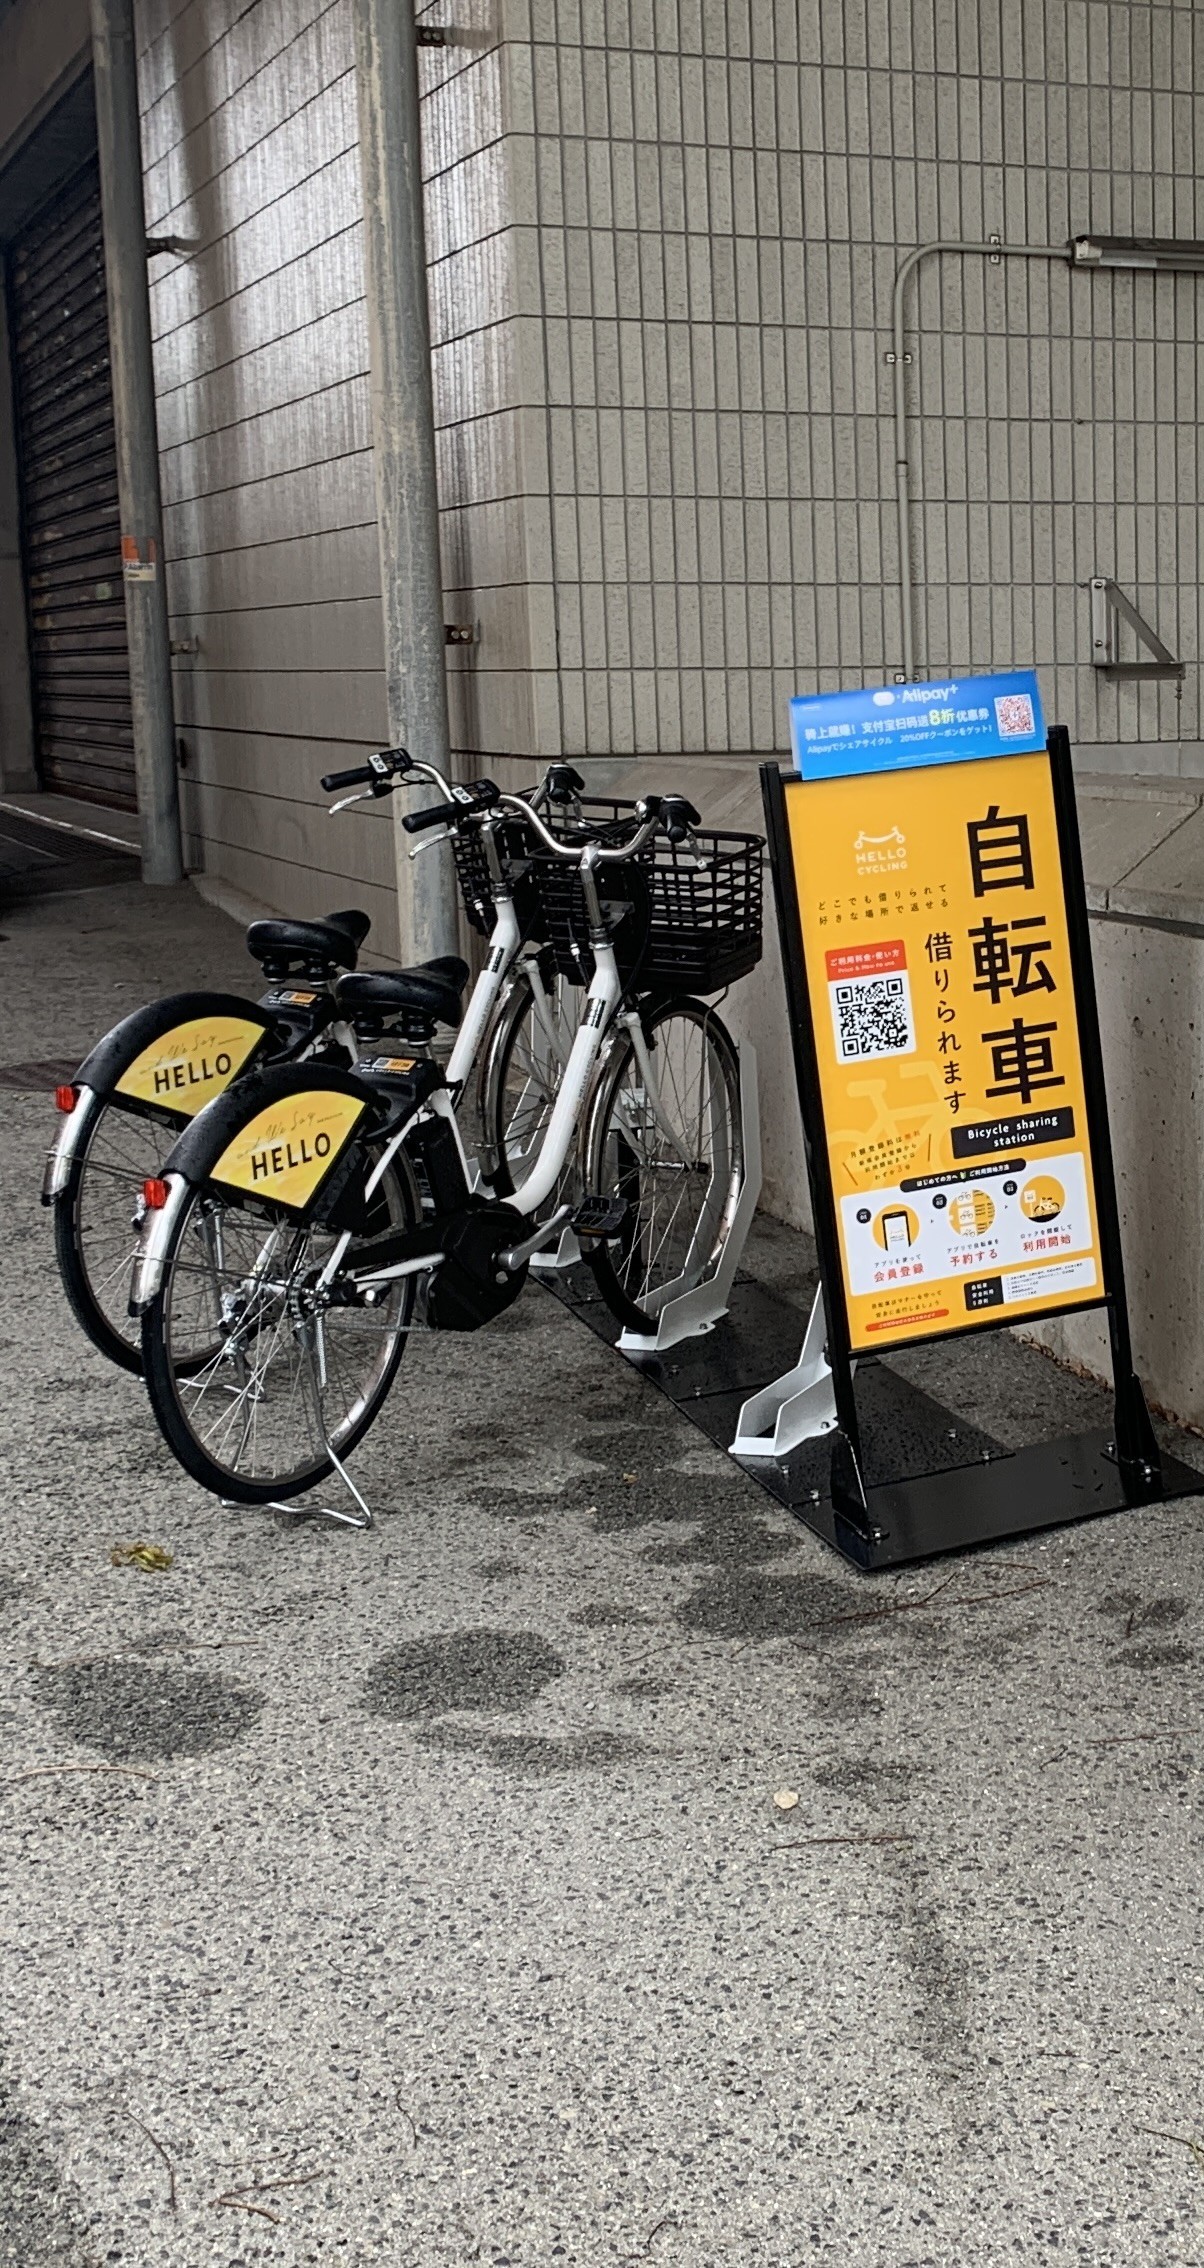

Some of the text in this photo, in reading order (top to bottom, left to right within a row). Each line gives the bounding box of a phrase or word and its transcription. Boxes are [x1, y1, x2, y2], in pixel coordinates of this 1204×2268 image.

[902, 684, 959, 704] Alipay+
[856, 847, 907, 864] HELLO
[857, 861, 908, 875] CYCLING
[818, 884, 947, 911] どこでも借りられて
[819, 898, 949, 926] 好きな場所で返せる
[967, 805, 1066, 1105] 自転車
[924, 931, 967, 1114] 借りられます
[154, 1053, 231, 1093] HELLO
[967, 1115, 1058, 1140] Bicycle sharing
[993, 1132, 1035, 1148] station
[251, 1132, 331, 1180] HELLO
[1023, 1234, 1072, 1252] 利用開始
[950, 1248, 998, 1267] 予約する
[874, 1263, 924, 1283] 会員登録
